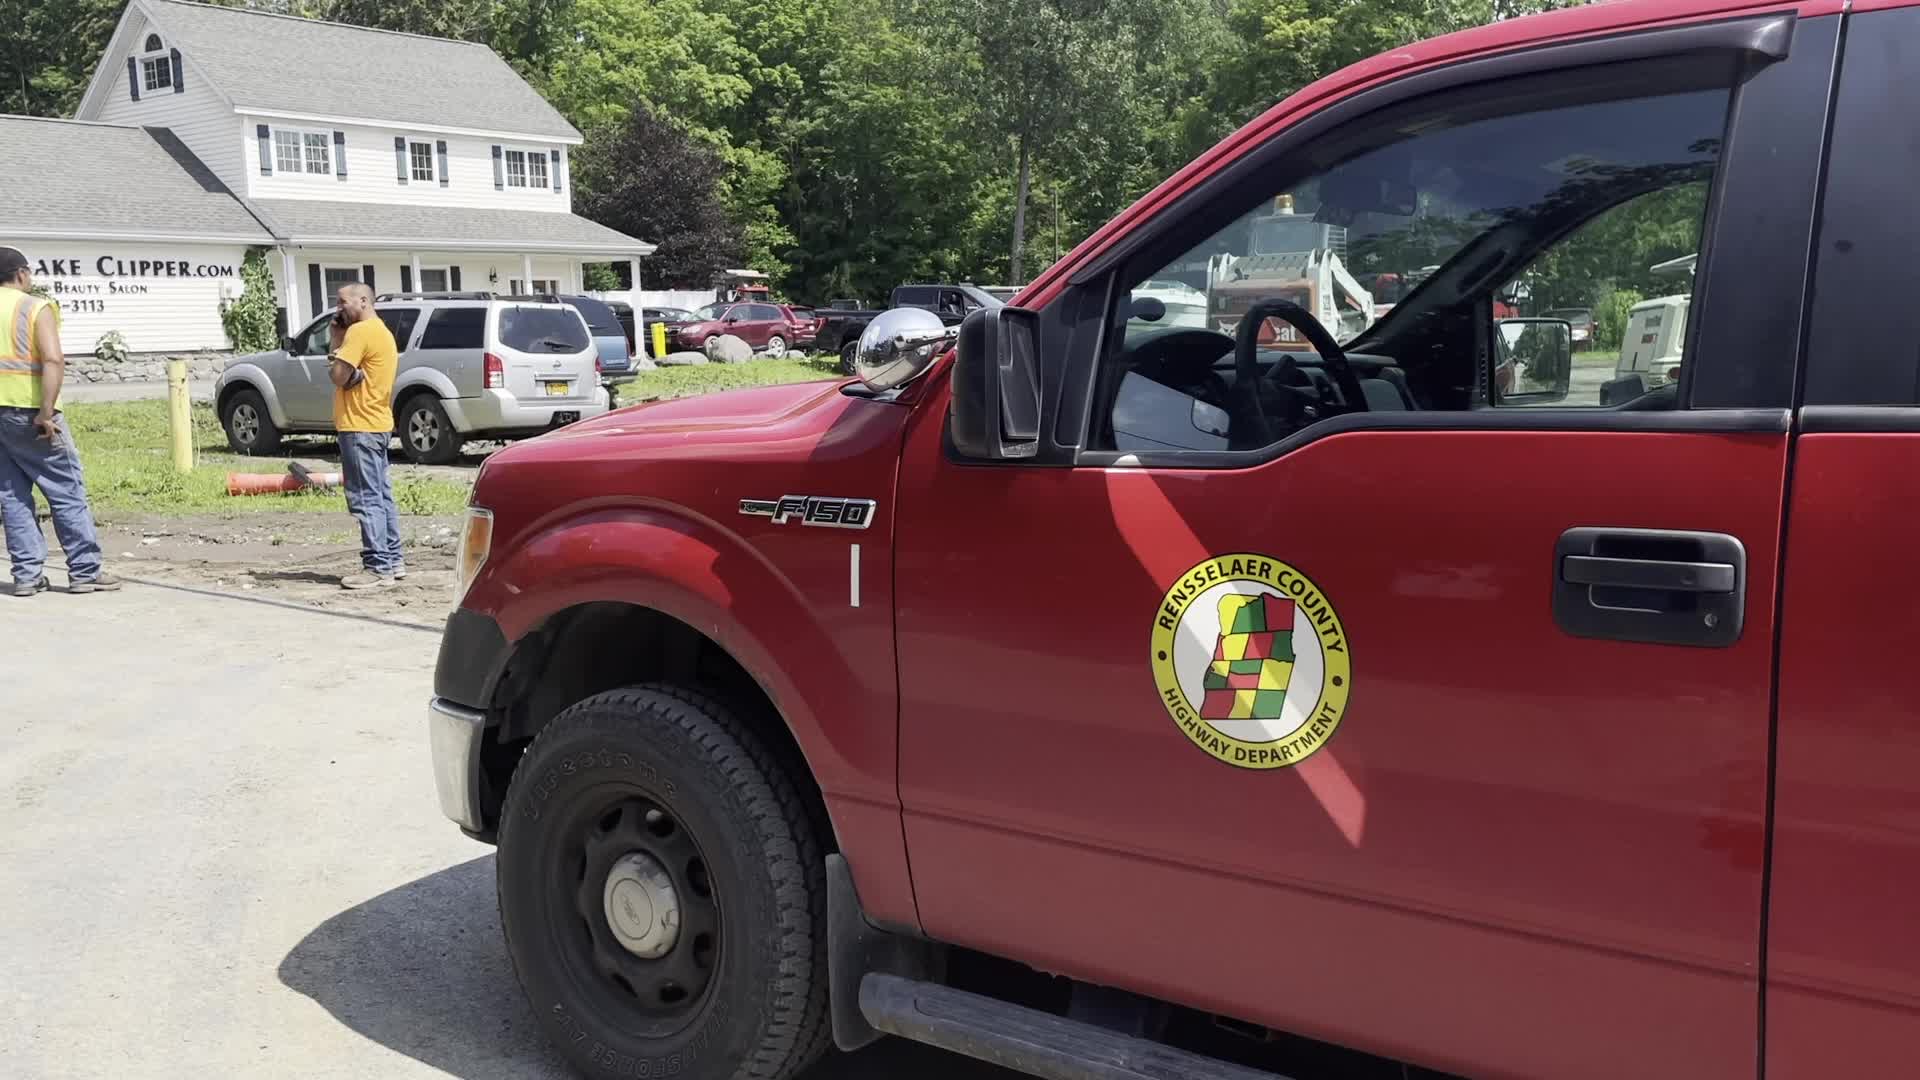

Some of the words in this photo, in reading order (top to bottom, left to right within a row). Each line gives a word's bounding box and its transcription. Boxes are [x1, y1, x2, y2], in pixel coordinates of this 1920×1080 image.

[34, 259, 81, 276] AKE
[54, 281, 100, 294] BEAUTY
[108, 281, 148, 294] SALON
[56, 299, 105, 313] -3113
[1159, 559, 1272, 631] RENSSELAER
[1277, 570, 1344, 653] COUNTY
[1164, 687, 1231, 756] HIGHWAY
[1234, 702, 1337, 764] DEPARTMENT
